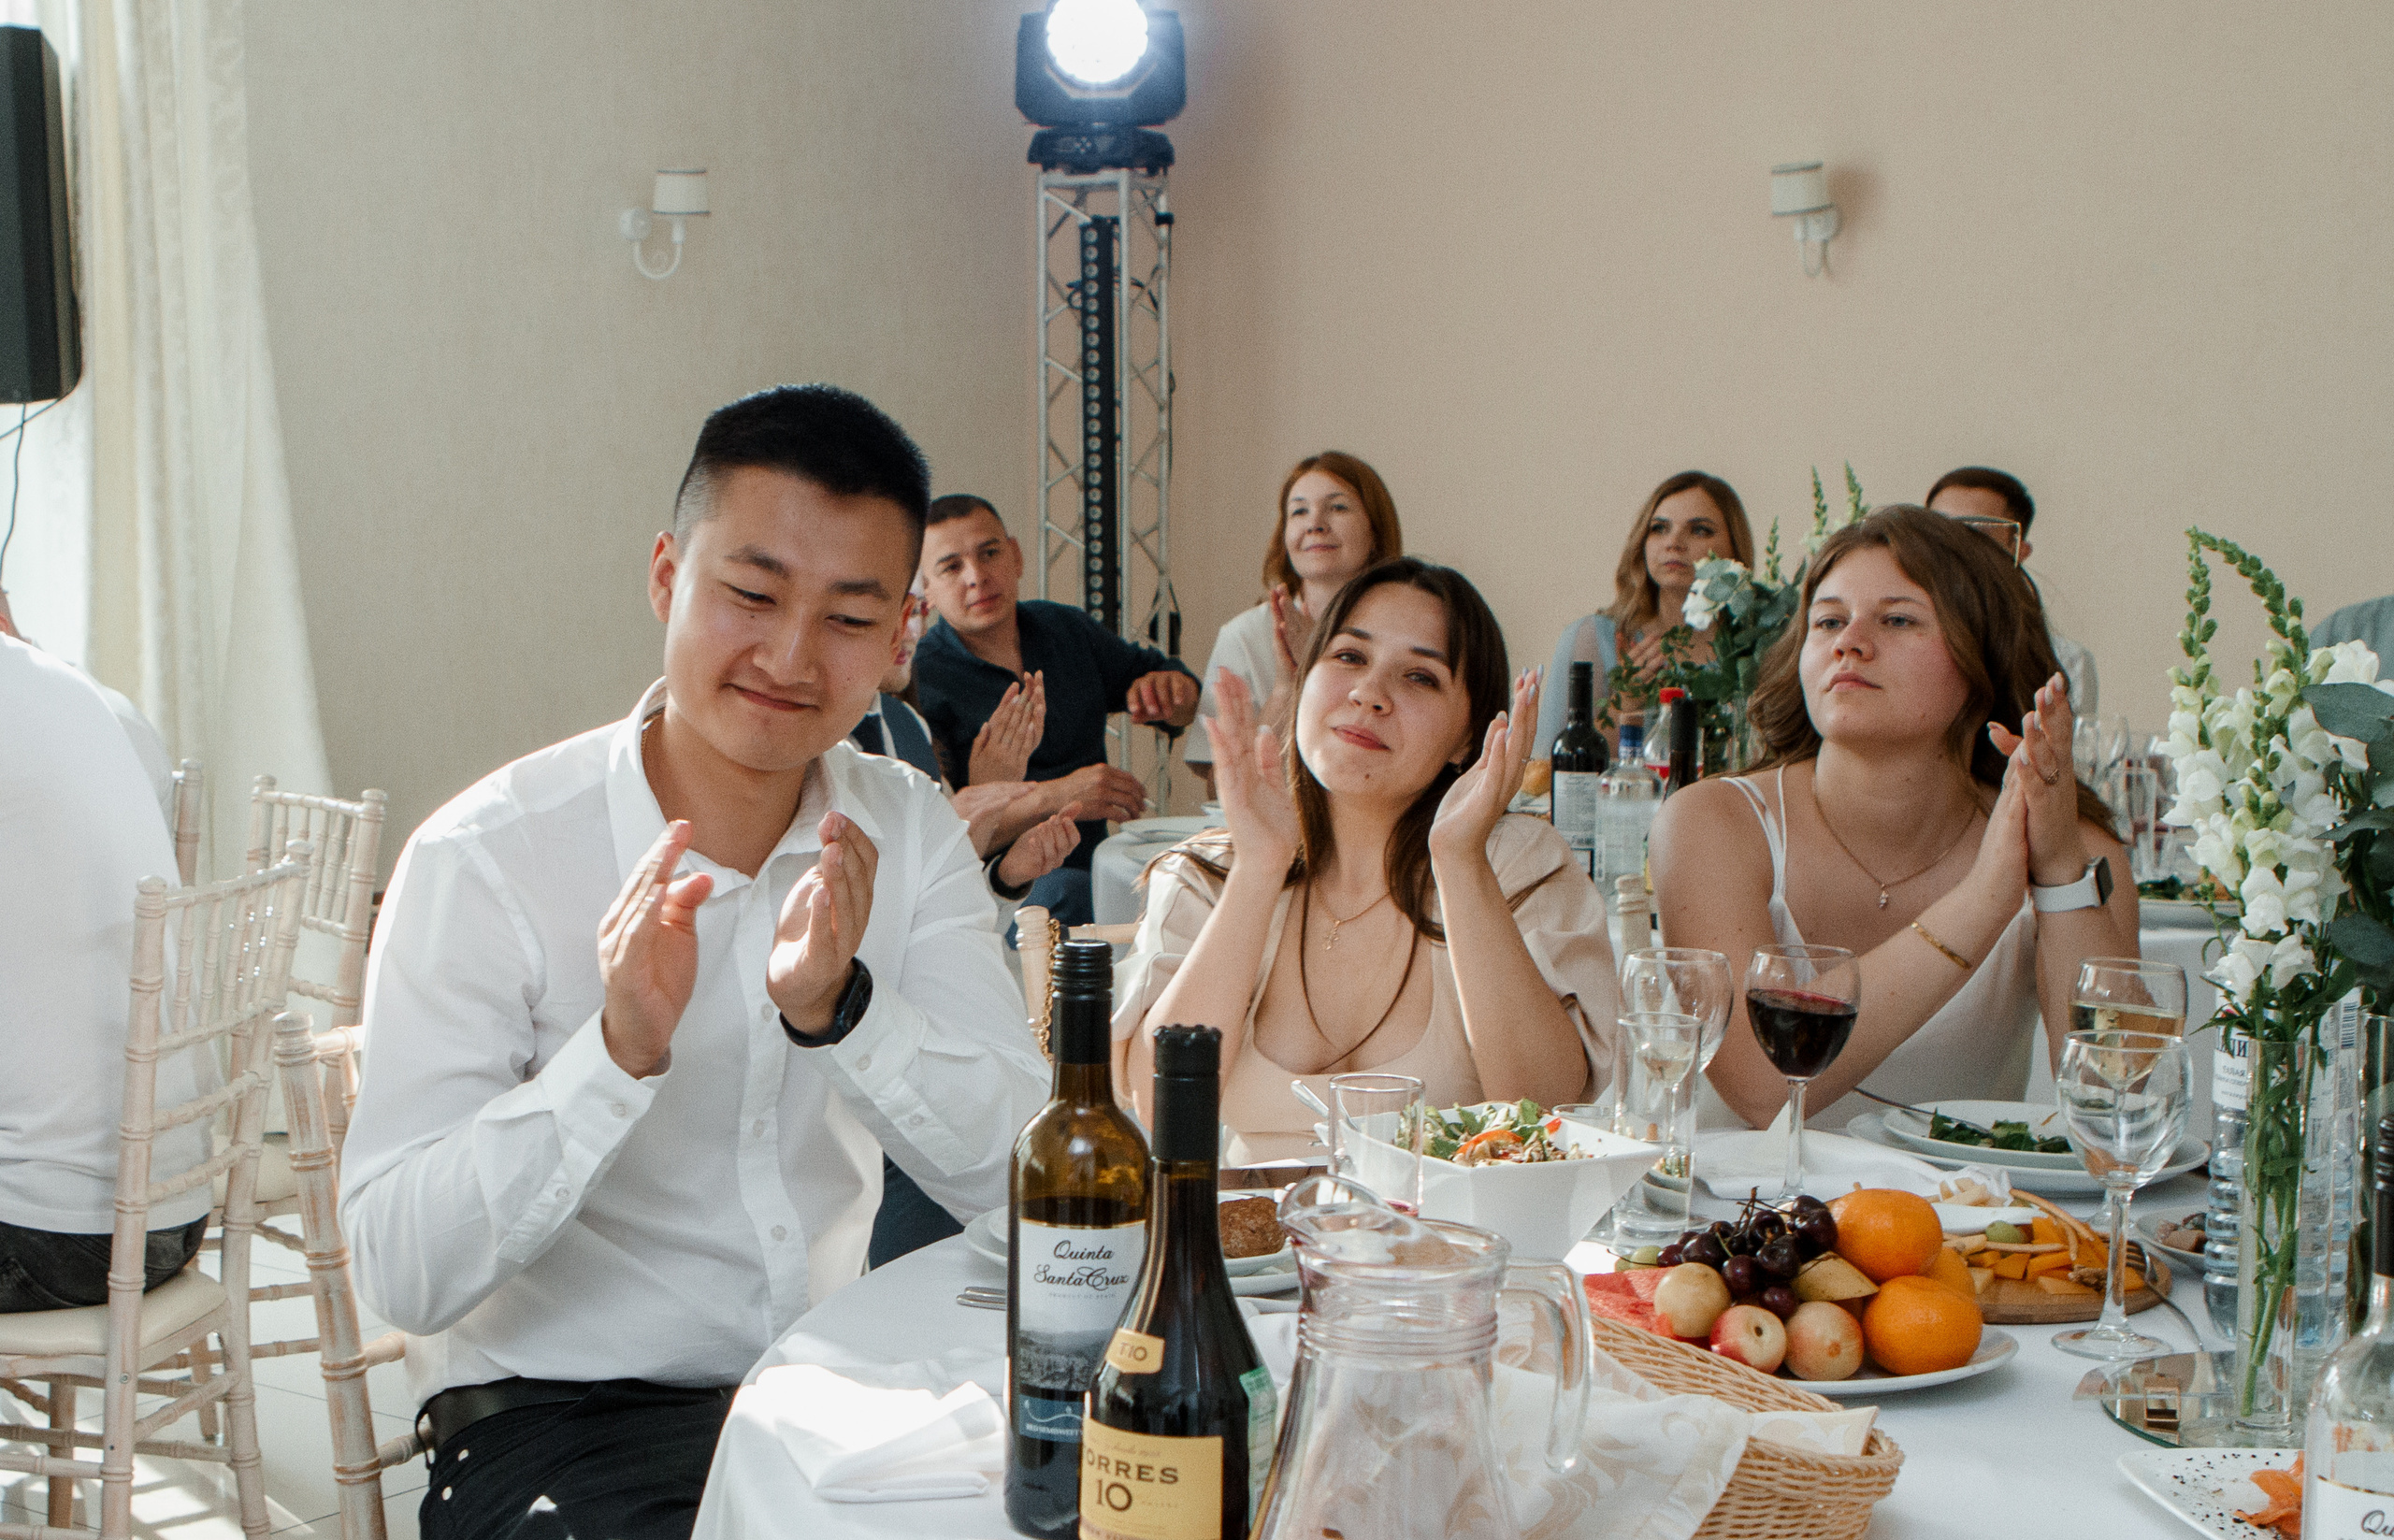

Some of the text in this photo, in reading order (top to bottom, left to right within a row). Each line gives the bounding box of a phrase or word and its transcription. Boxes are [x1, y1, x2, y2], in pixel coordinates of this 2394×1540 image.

[1053, 1240, 1114, 1259] Quinta
[1033, 1264, 1129, 1291] Santa Cruz
[1084, 1446, 1179, 1485] ORRES
[1096, 1478, 1133, 1513] 10
